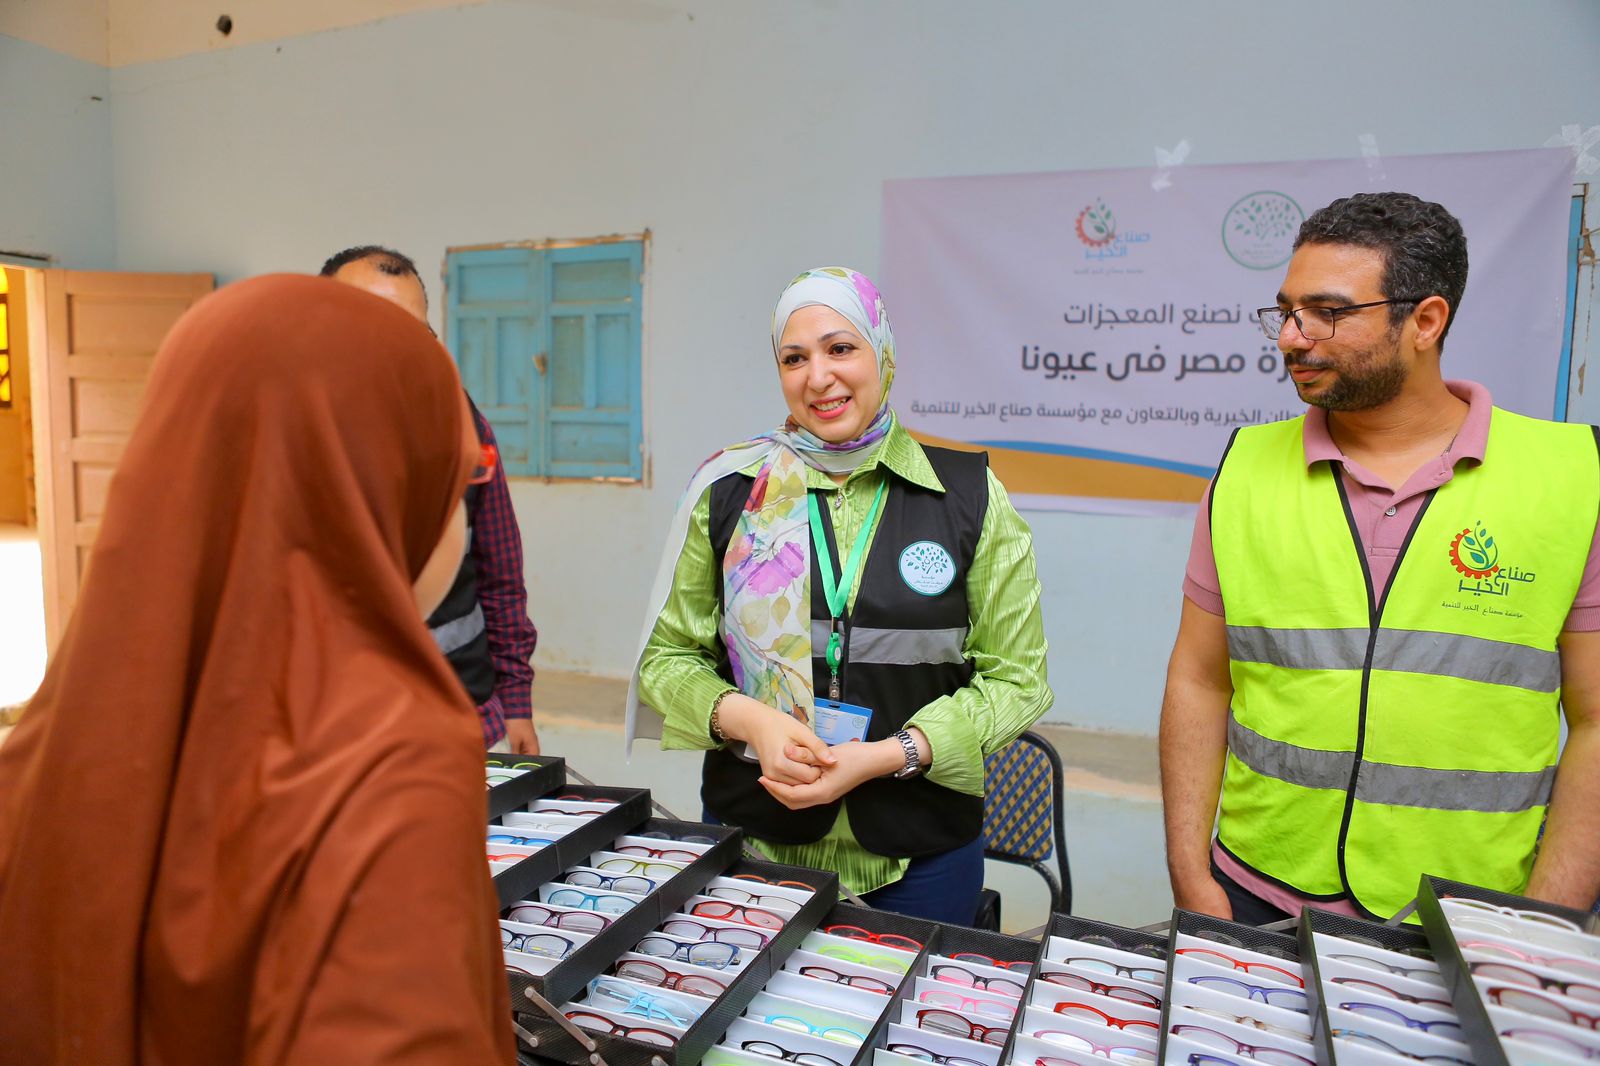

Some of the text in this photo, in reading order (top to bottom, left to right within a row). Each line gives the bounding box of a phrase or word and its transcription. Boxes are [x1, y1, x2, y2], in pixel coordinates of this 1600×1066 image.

[1063, 303, 1174, 331] المعجزات
[1181, 303, 1241, 334] نصنع
[1021, 345, 1098, 381] عيونا
[1174, 353, 1246, 381] مصر
[910, 400, 961, 418] للتنمية
[963, 402, 996, 419] الخير
[1000, 403, 1033, 423] صناع
[1036, 403, 1097, 423] مؤسسة
[1101, 407, 1123, 426] مع
[1126, 406, 1200, 426] وبالتعاون
[1203, 407, 1262, 427] الخيرية
[1494, 566, 1536, 587] صناع
[1458, 578, 1510, 597] الخير
